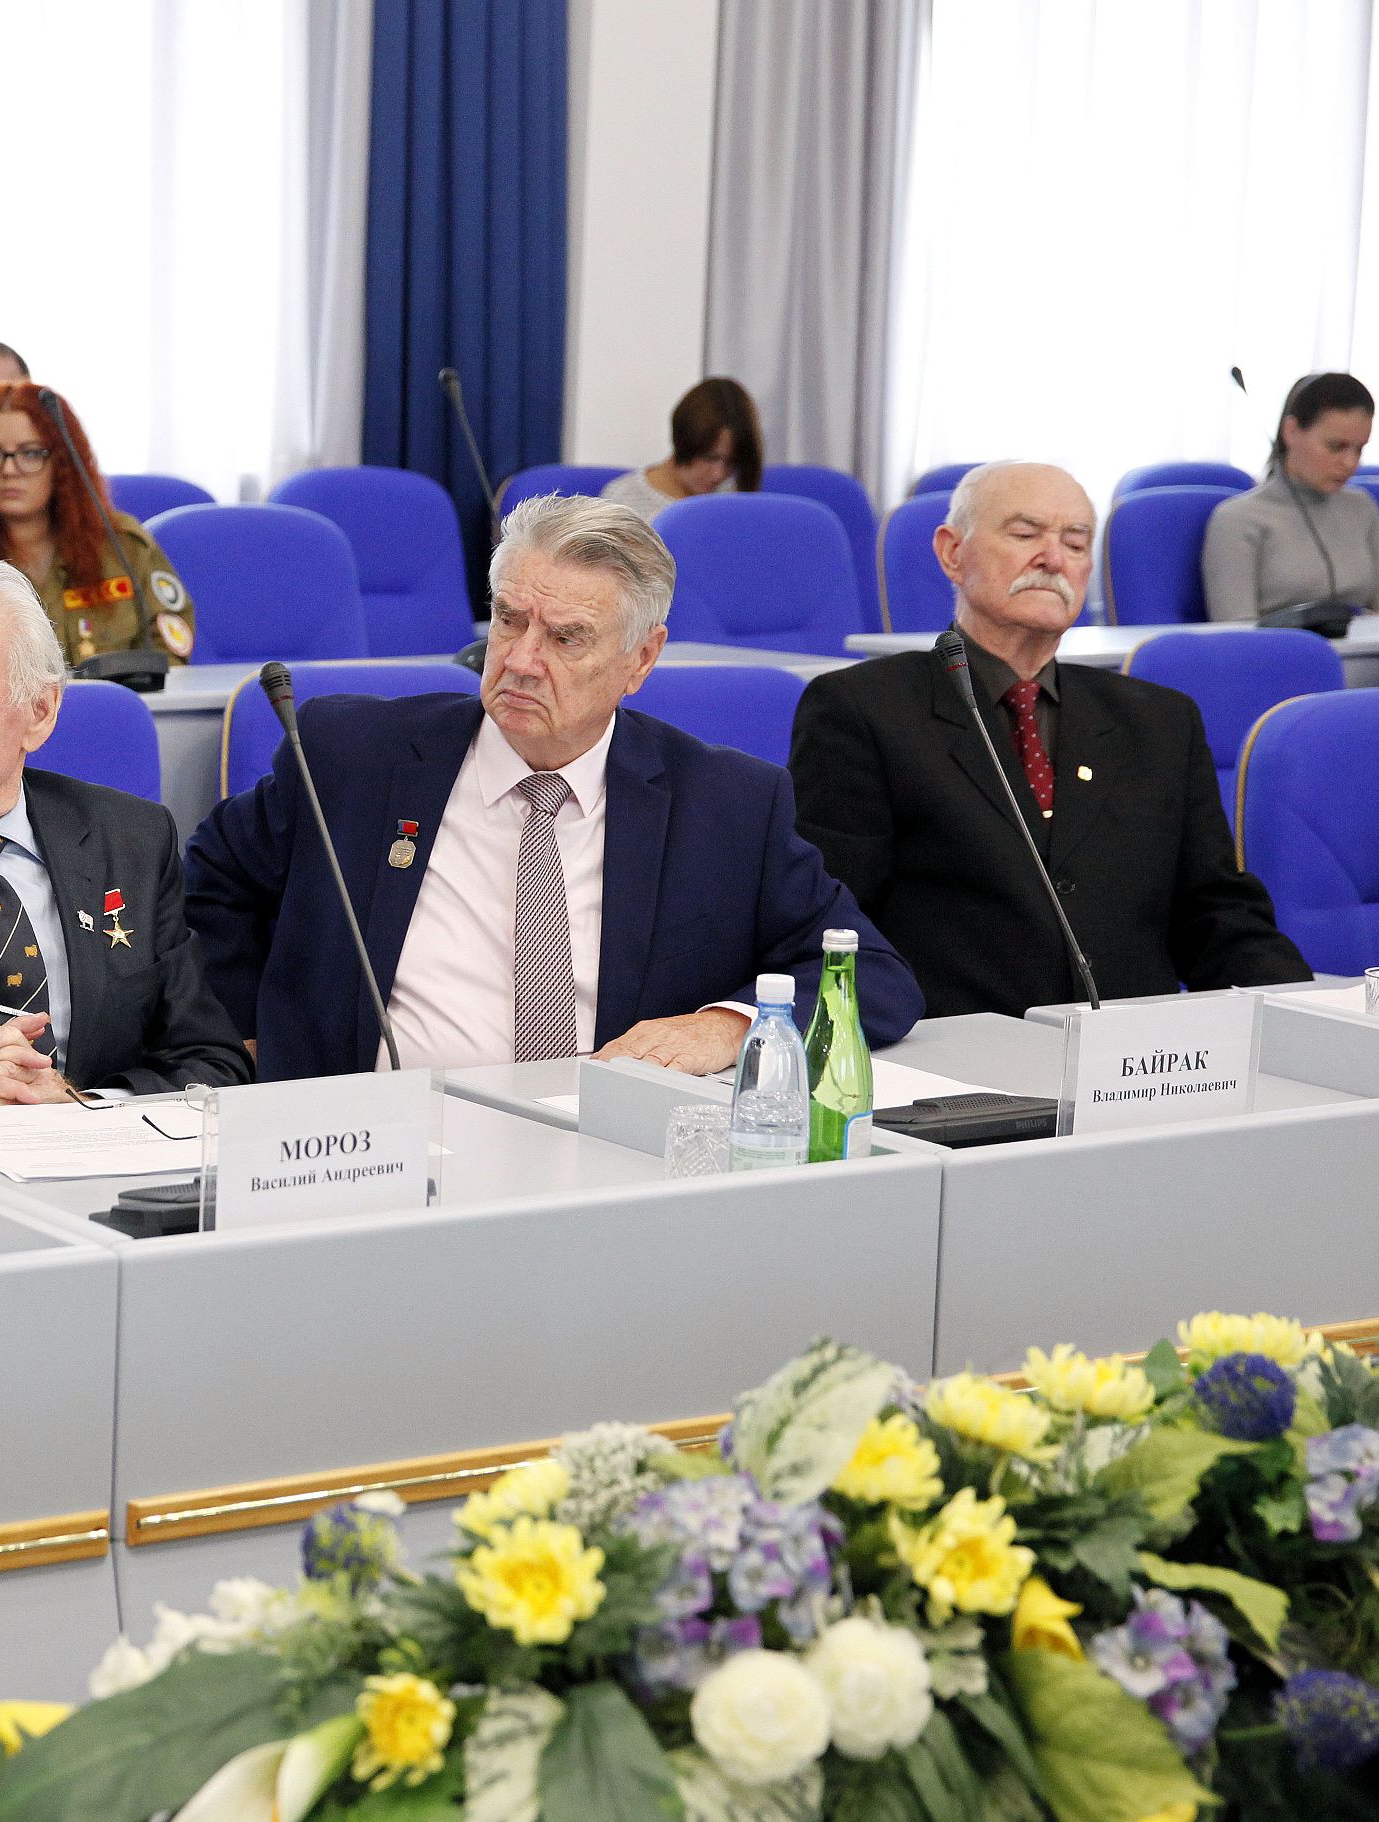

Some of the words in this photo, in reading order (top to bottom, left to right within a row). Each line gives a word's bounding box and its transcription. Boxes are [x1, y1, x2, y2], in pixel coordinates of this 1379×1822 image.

[1121, 1049, 1209, 1077] БАЙРАК
[1092, 1086, 1157, 1103] Владимир
[1160, 1079, 1237, 1097] Николаевич
[1015, 1118, 1047, 1129] PHILIPS
[280, 1130, 371, 1162] МОРОЗ
[251, 1169, 317, 1192] Василий
[322, 1161, 404, 1184] Андреевич
